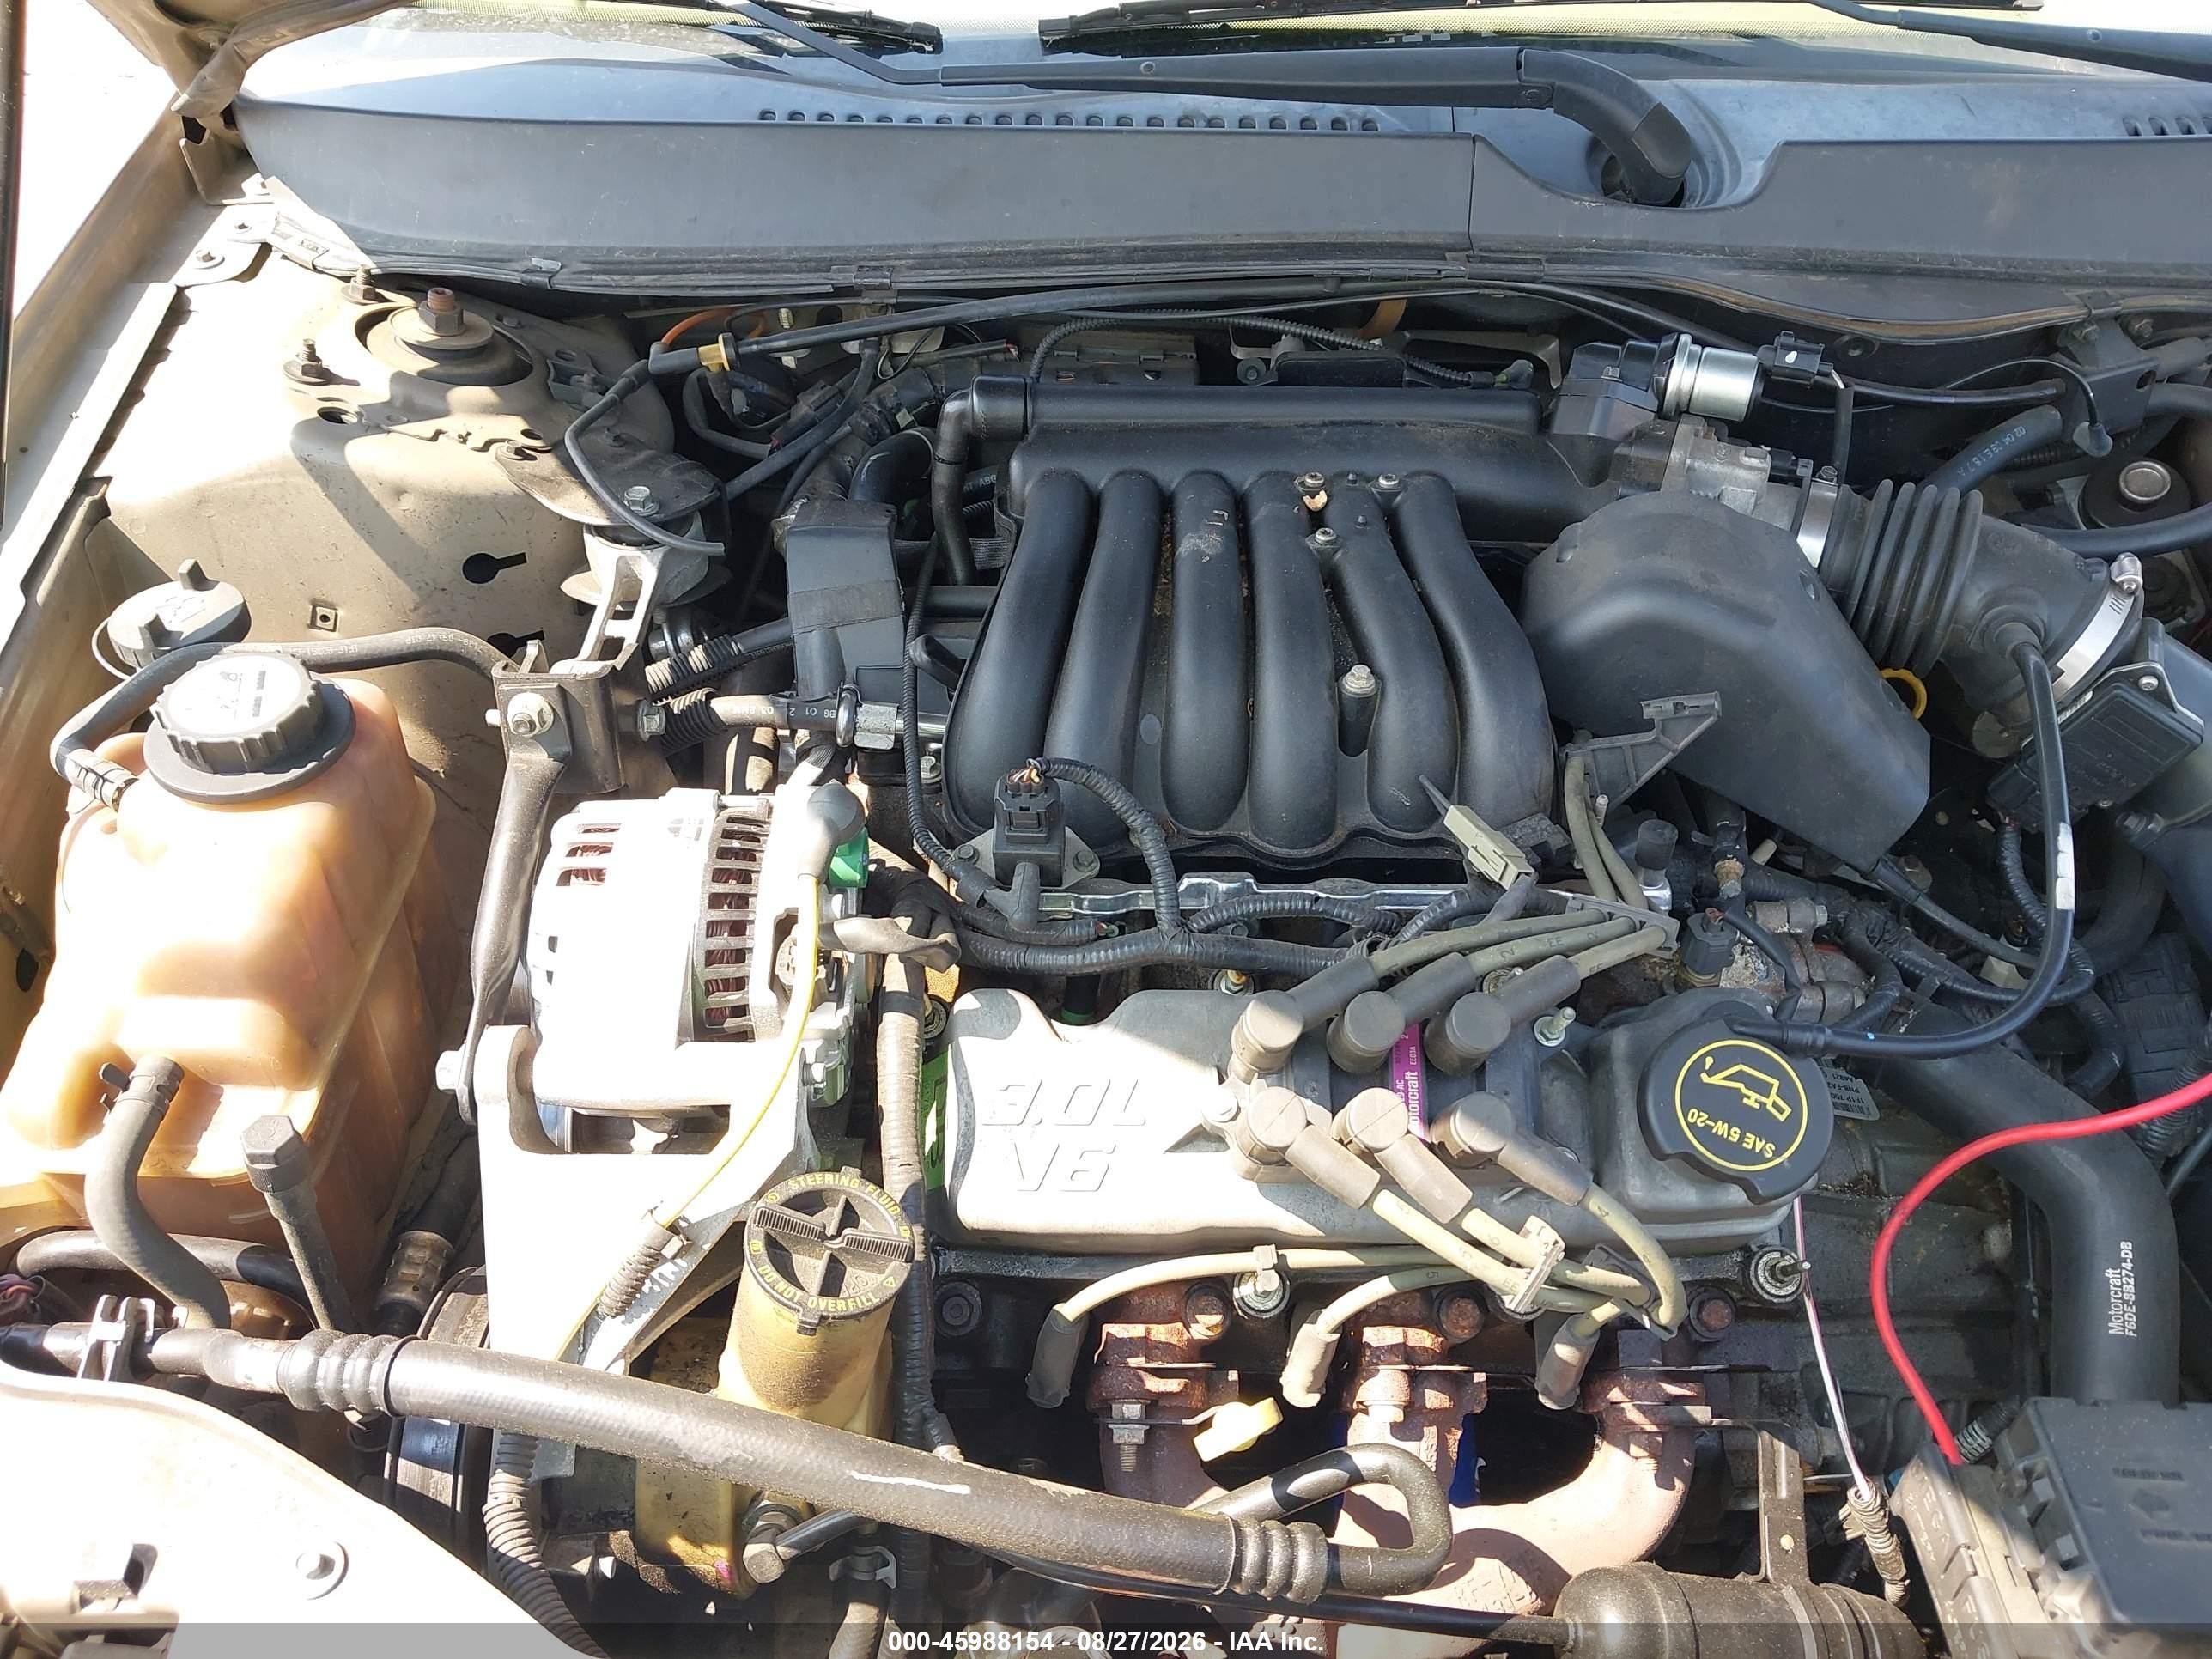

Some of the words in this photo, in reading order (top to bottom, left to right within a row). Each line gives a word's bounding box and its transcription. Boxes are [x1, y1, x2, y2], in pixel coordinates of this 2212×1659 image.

[789, 708, 796, 716] 2
[981, 1079, 1147, 1126] 3.0L
[1686, 1106, 1742, 1141] 5W-20
[1013, 1142, 1117, 1192] V6
[1743, 1132, 1776, 1159] SAE
[787, 1173, 861, 1190] STEERING
[865, 1183, 902, 1216] FLUID
[757, 1264, 775, 1283] DO
[775, 1279, 804, 1302] NOT
[807, 1291, 881, 1312] OVERFILL
[2105, 1267, 2124, 1335] Motorcraft
[2119, 1241, 2136, 1337] F6DE-8B274-DB
